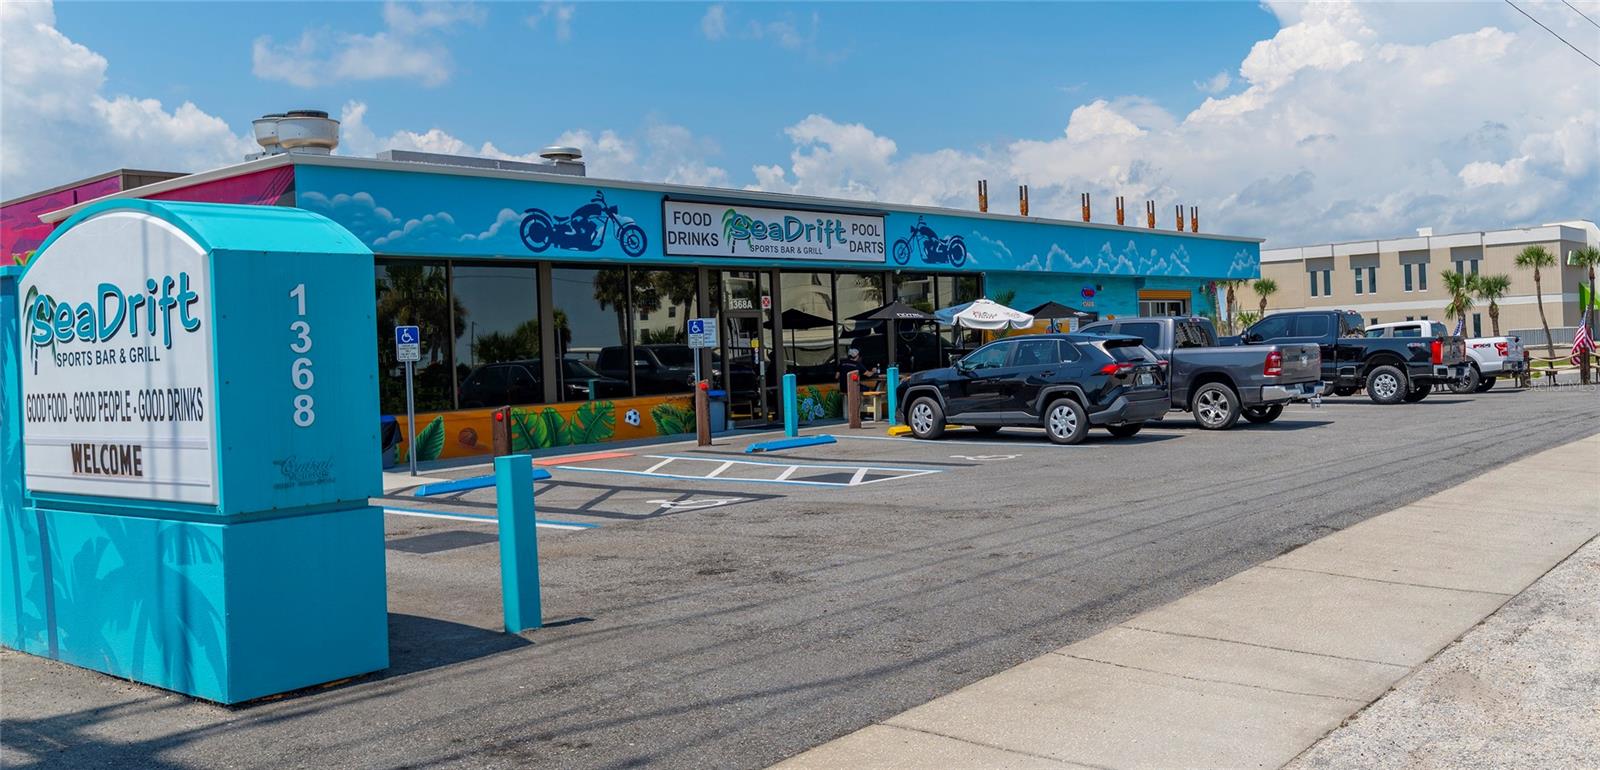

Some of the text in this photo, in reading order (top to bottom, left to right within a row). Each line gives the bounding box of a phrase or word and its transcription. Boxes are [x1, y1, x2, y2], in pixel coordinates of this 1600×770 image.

[673, 211, 712, 227] FOOD
[851, 223, 881, 237] POOL
[667, 231, 719, 247] DRINKS
[730, 213, 848, 249] SeaDrift
[750, 244, 823, 255] SPORTS BAR & GRILL
[850, 240, 884, 254] DARTS
[31, 271, 201, 350] SeaDrift
[56, 346, 160, 368] SPORTS BAR & GRILL
[289, 283, 316, 428] 1368
[26, 393, 46, 423] GOOD
[48, 393, 68, 423] FOOD
[74, 391, 97, 423] GOOD
[98, 390, 132, 422] PEOPLE
[138, 389, 165, 422] GOOD
[168, 387, 204, 422] DRINKS
[71, 443, 144, 477] WELCOME
